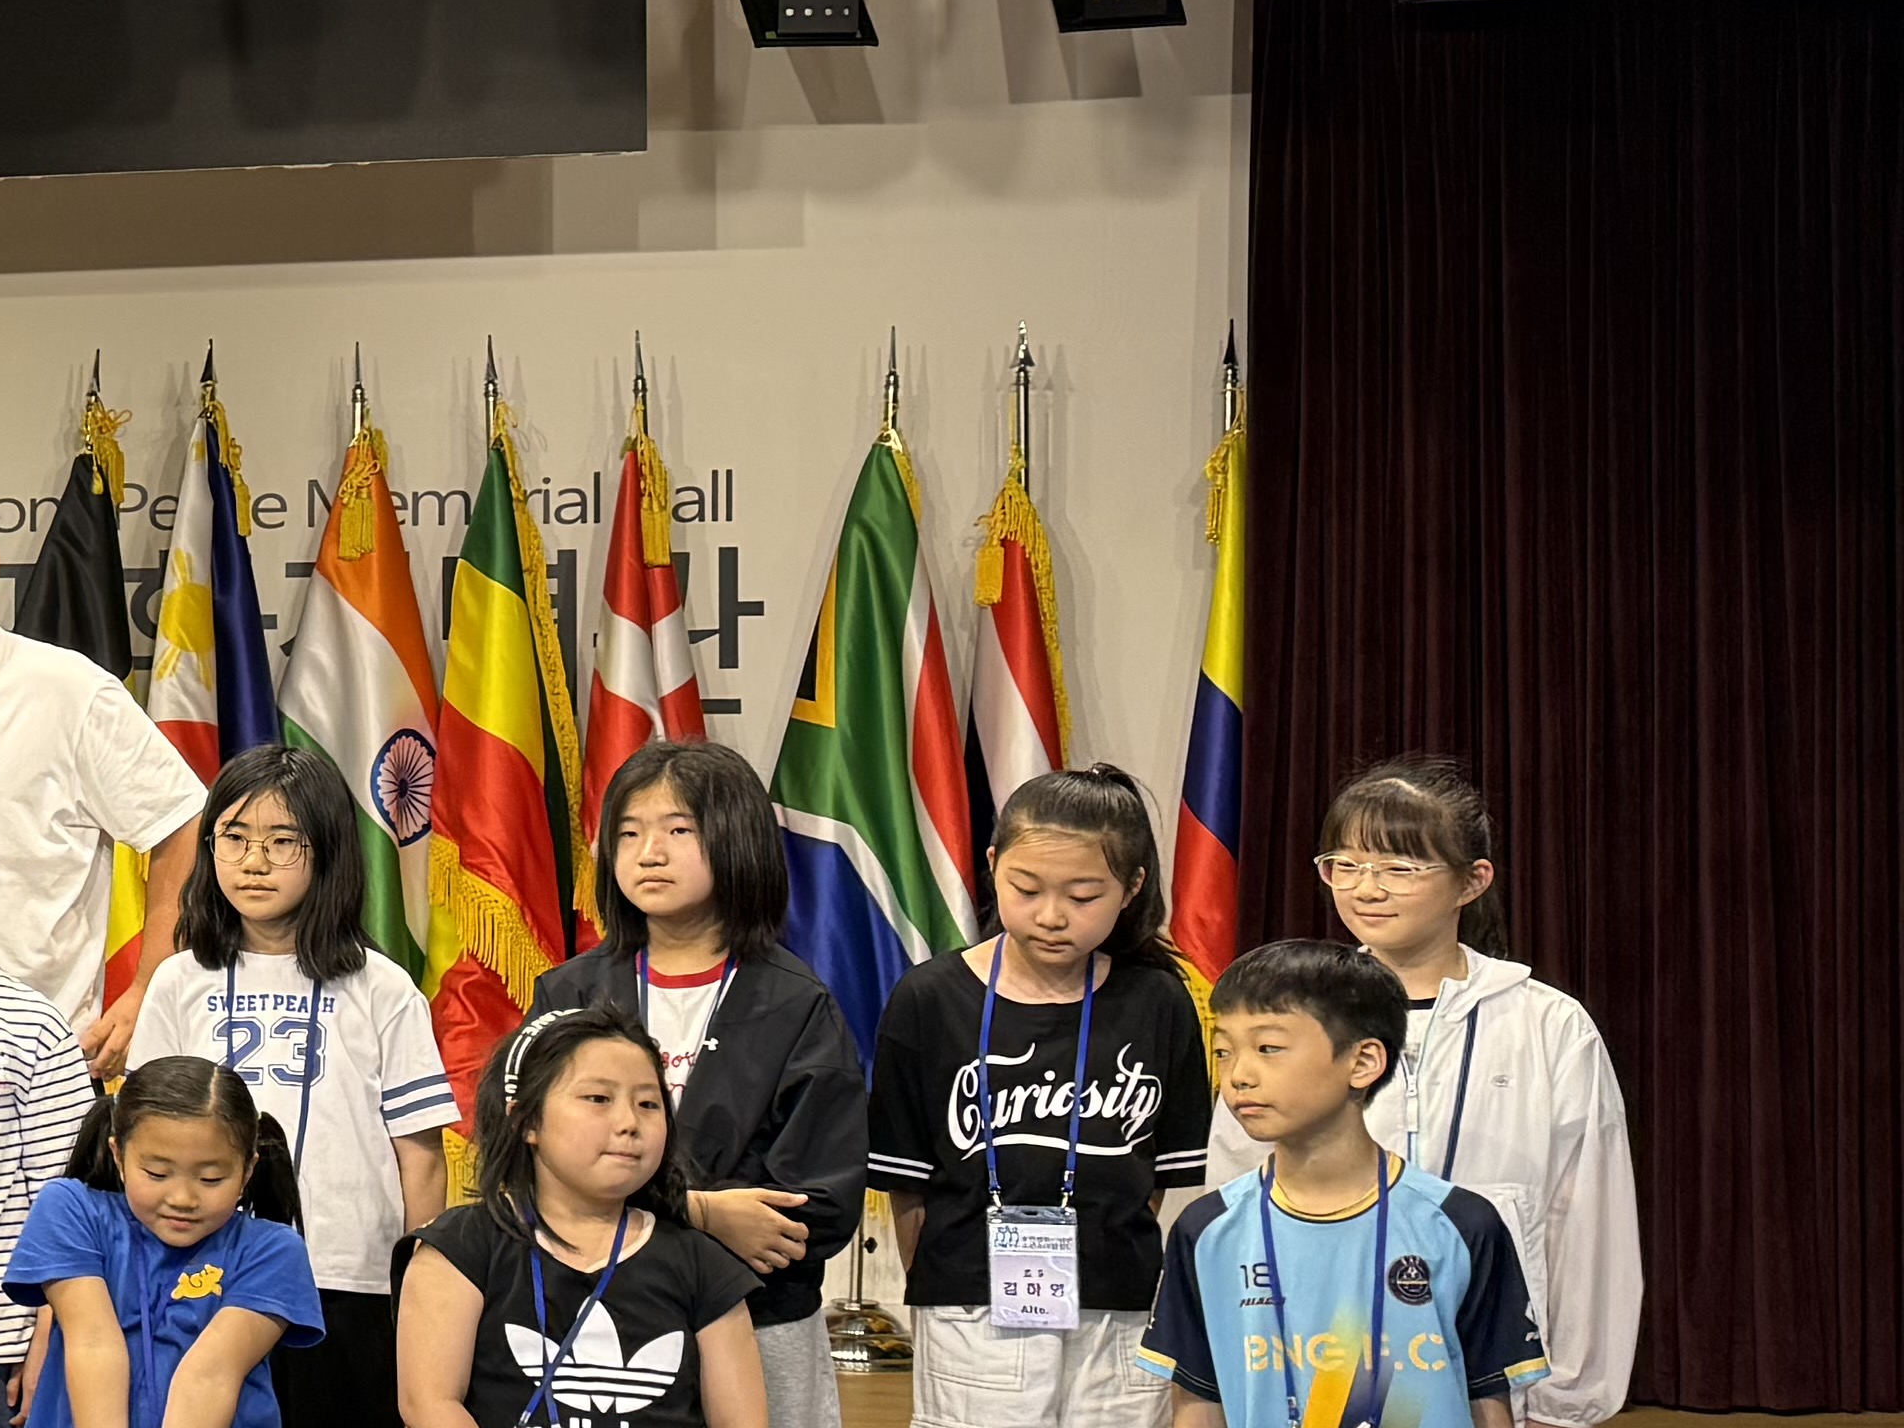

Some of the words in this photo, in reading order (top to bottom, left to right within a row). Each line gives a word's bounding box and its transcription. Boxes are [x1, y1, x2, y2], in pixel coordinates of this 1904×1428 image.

[117, 482, 288, 529] Pee
[672, 468, 734, 524] all
[272, 993, 336, 1013] PEAH
[212, 1015, 328, 1087] 23
[947, 1042, 1163, 1154] Curiosity
[1244, 1331, 1346, 1372] BNG
